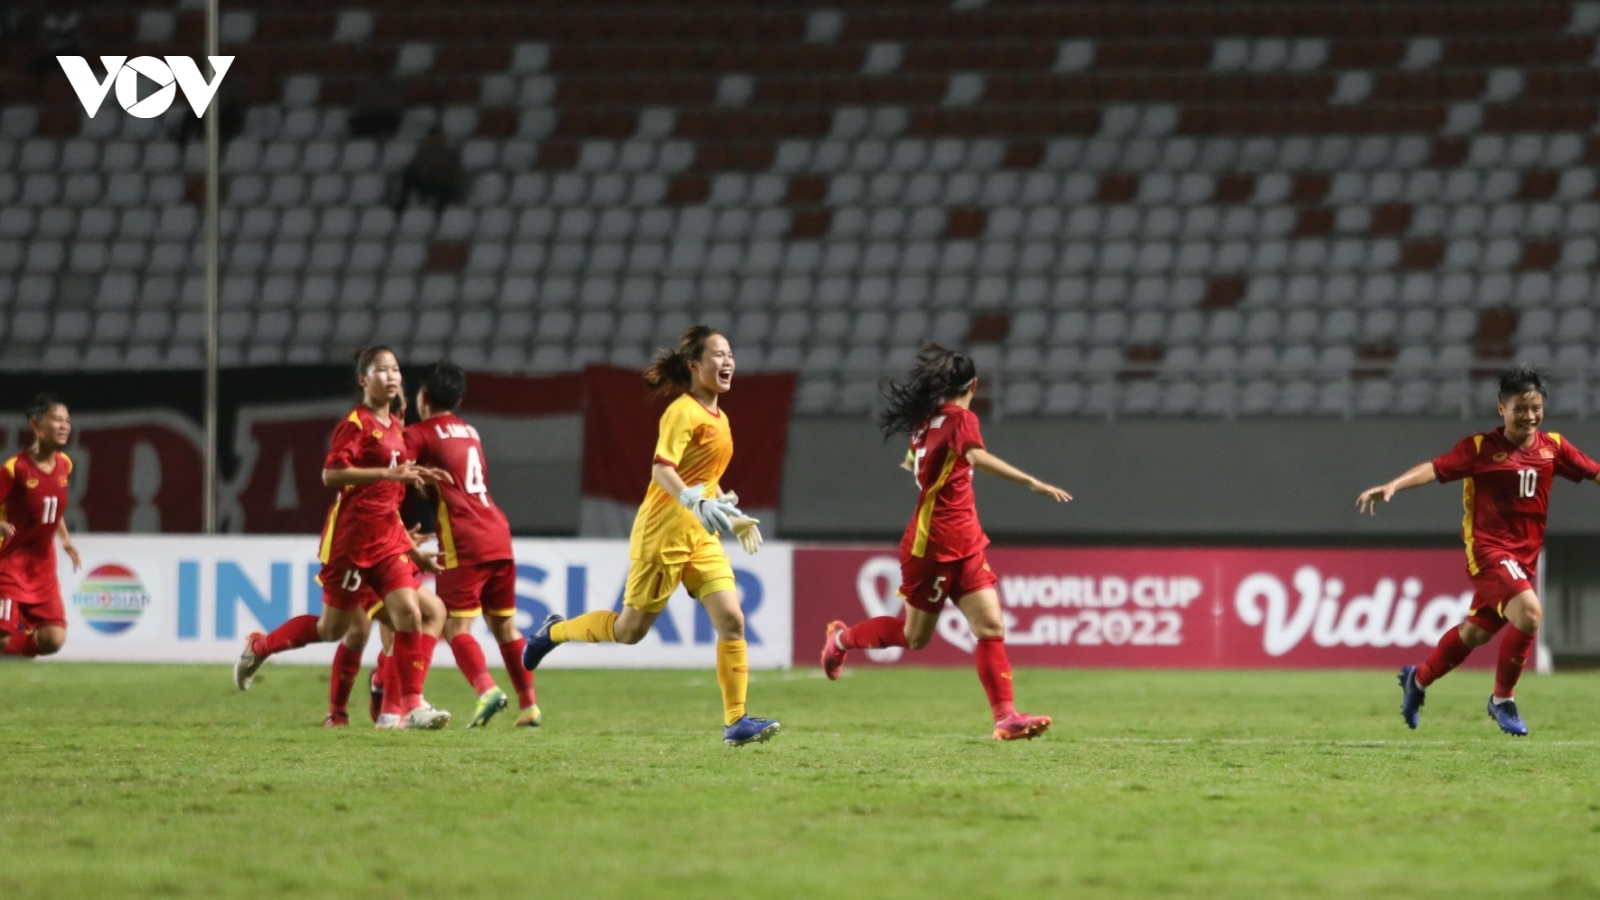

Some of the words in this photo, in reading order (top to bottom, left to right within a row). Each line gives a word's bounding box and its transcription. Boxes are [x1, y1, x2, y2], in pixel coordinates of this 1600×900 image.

[465, 446, 490, 507] 4
[1518, 469, 1537, 498] 10
[42, 496, 58, 524] 11
[341, 569, 362, 592] 15
[928, 576, 946, 602] 5
[1003, 576, 1127, 608] WORLD
[1132, 576, 1202, 608] CUP
